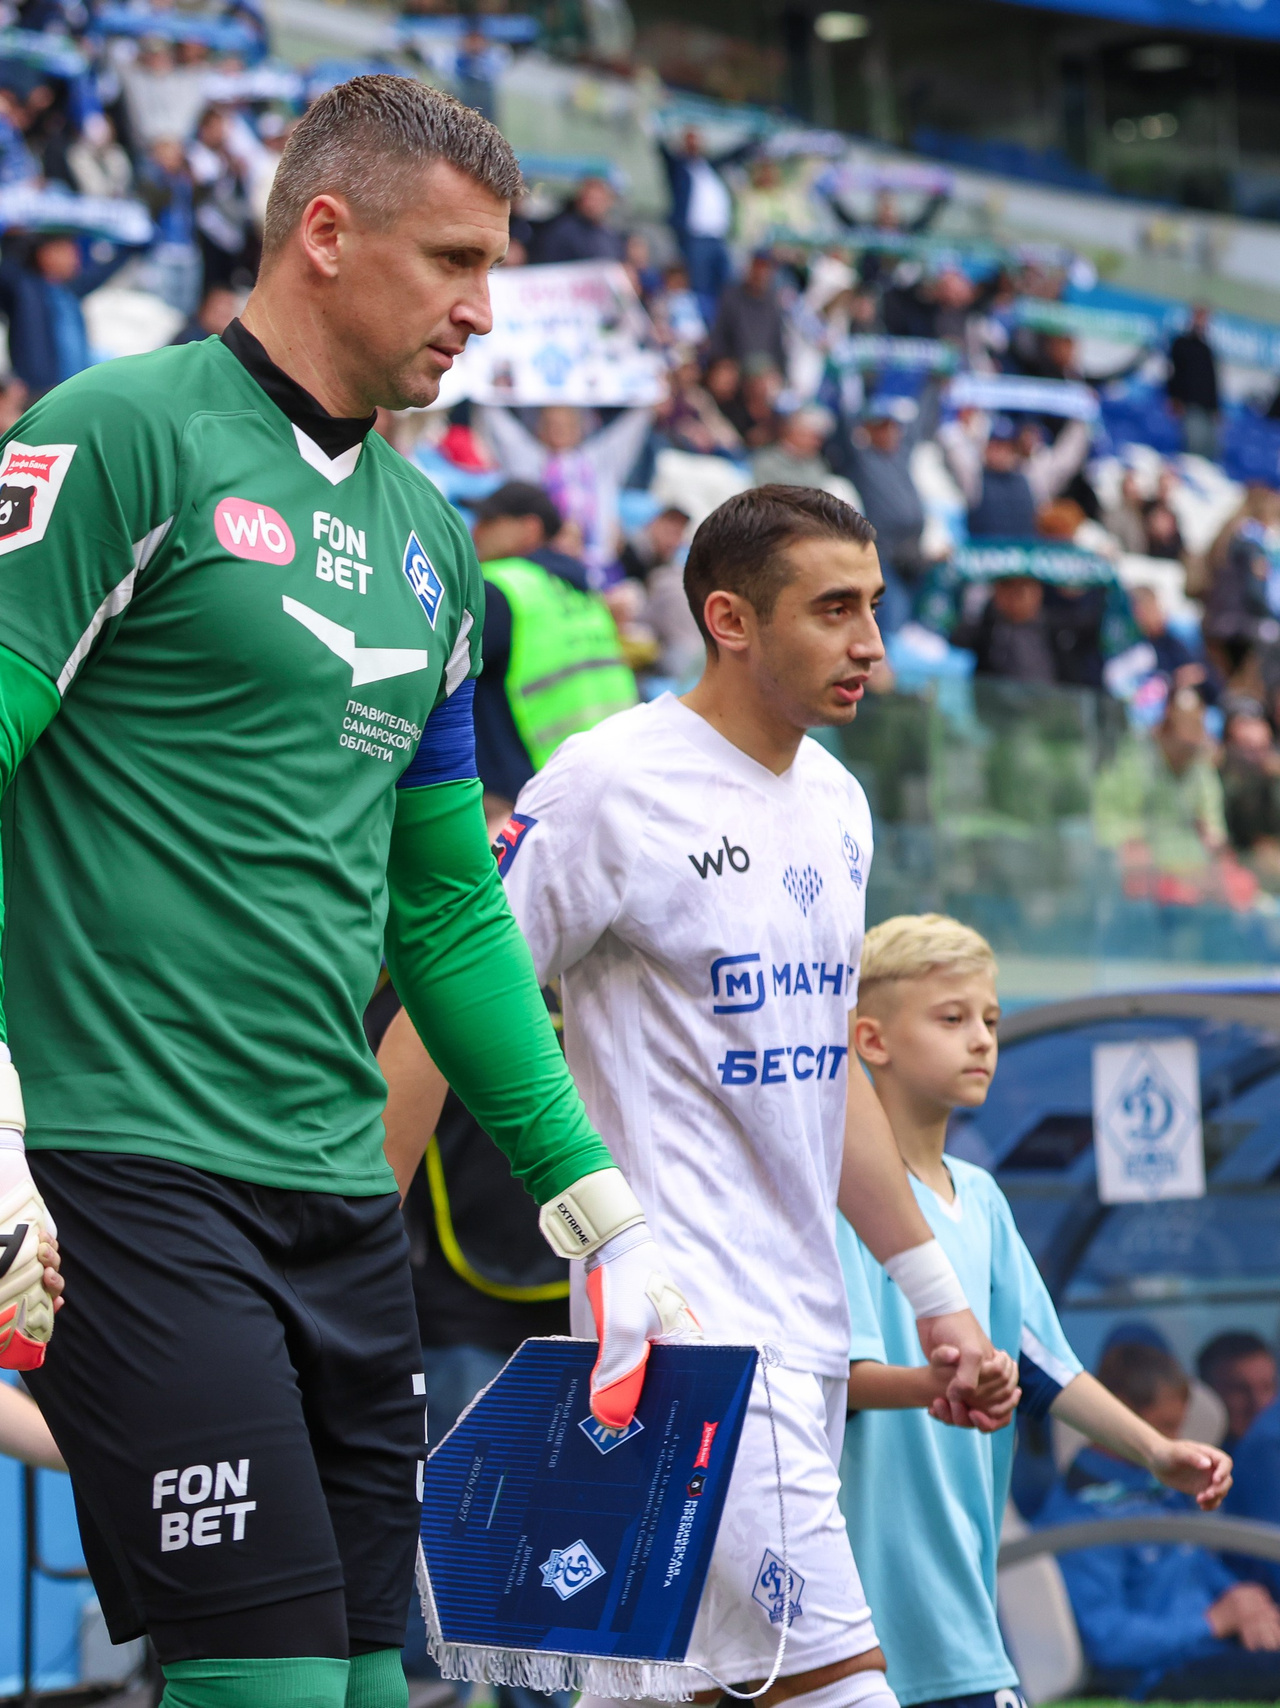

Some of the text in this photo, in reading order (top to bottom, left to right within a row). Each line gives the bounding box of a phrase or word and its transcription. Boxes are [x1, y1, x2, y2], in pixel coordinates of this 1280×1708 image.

[28, 460, 49, 471] Банк
[222, 508, 287, 554] wb
[312, 510, 367, 560] FON
[315, 545, 374, 595] BET
[339, 733, 394, 763] ОБЛАСТИ
[342, 716, 412, 752] САМАРСКОЙ
[687, 835, 750, 880] wb
[556, 1202, 591, 1247] EXTREME
[546, 1403, 564, 1442] Самара
[547, 1378, 579, 1468] КРЫЛЬЯ СОВЕТОВ
[152, 1458, 250, 1510] FON
[458, 1455, 484, 1522] 2026/2027
[161, 1500, 257, 1552] BET
[663, 1500, 691, 1588] ПРЕМЬЕР-ЛИГА
[673, 1500, 699, 1576] РОССИЙСКАЯ
[515, 1545, 533, 1586] ДИНАМО
